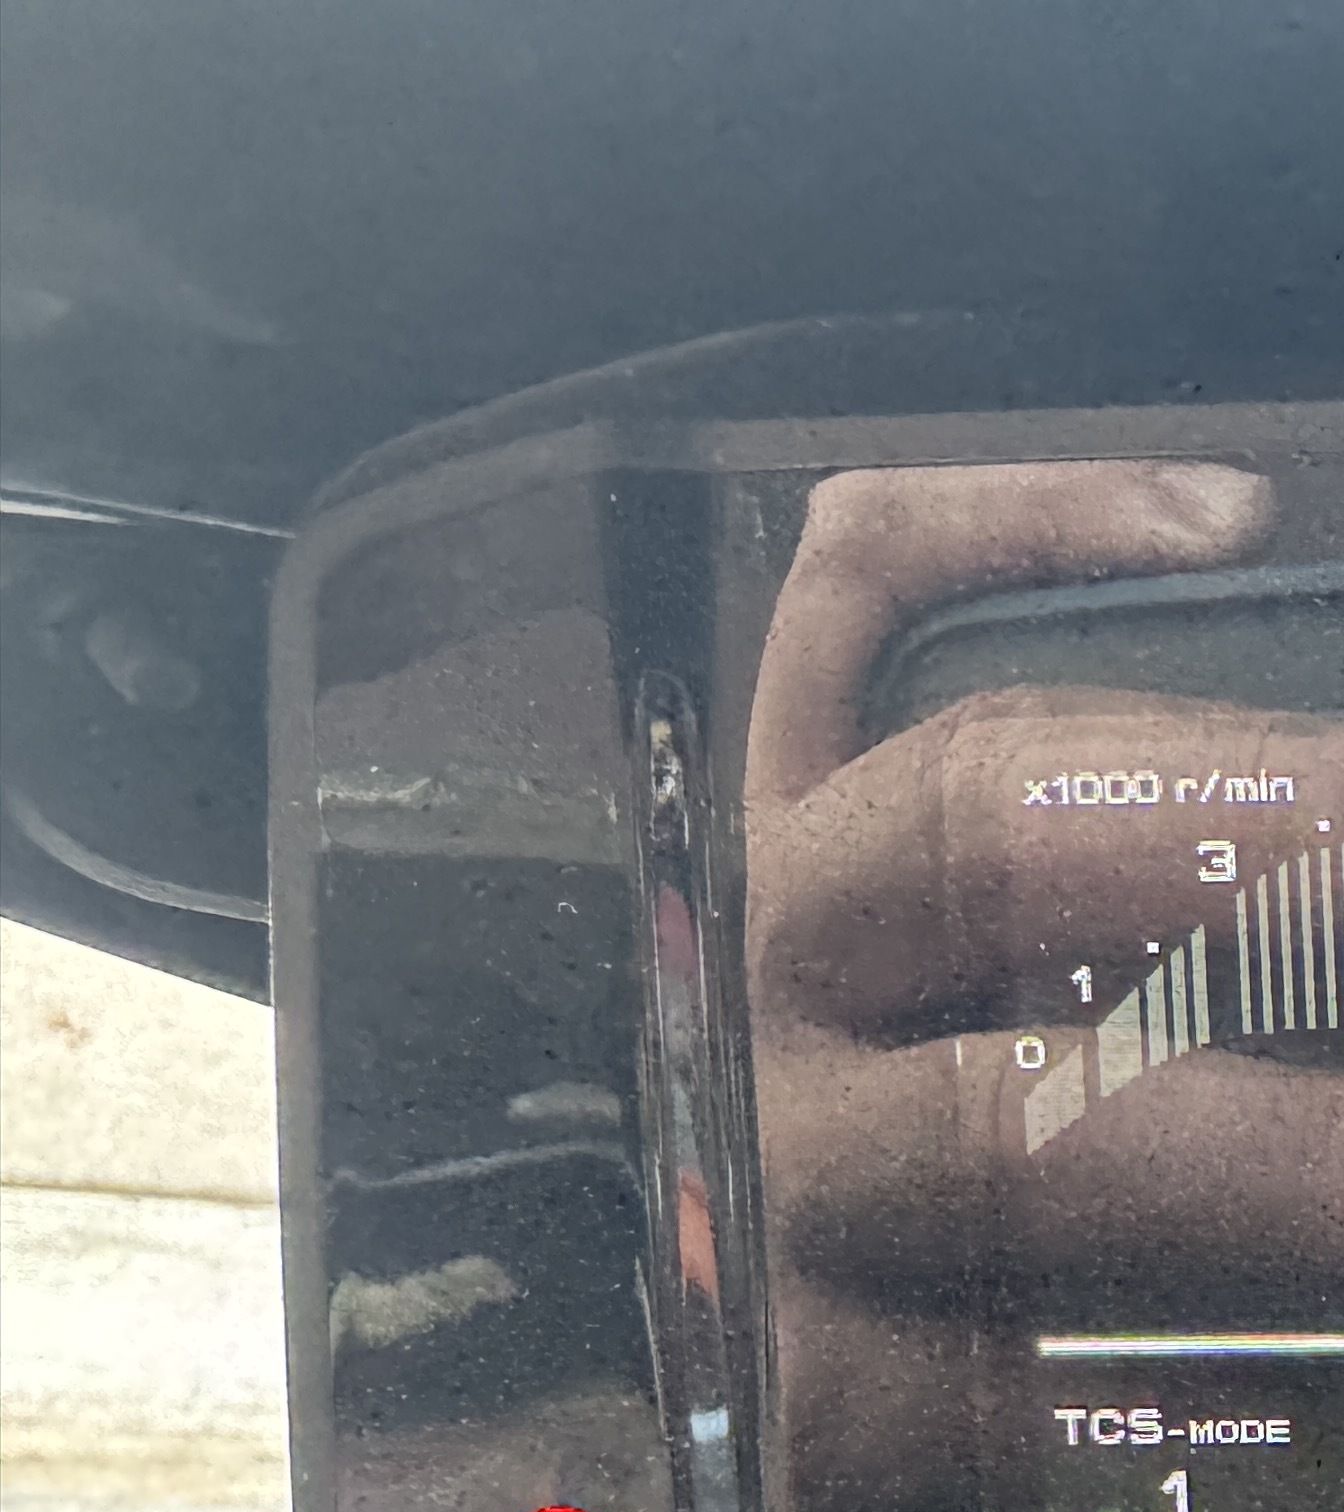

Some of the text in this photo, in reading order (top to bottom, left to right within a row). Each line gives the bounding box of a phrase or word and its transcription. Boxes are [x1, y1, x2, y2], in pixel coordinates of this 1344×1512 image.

[1176, 768, 1295, 804] r/min
[1198, 840, 1236, 882] 3
[1071, 965, 1092, 1002] 1
[1015, 1036, 1045, 1068] 0
[1054, 1408, 1291, 1445] TCS-MODE
